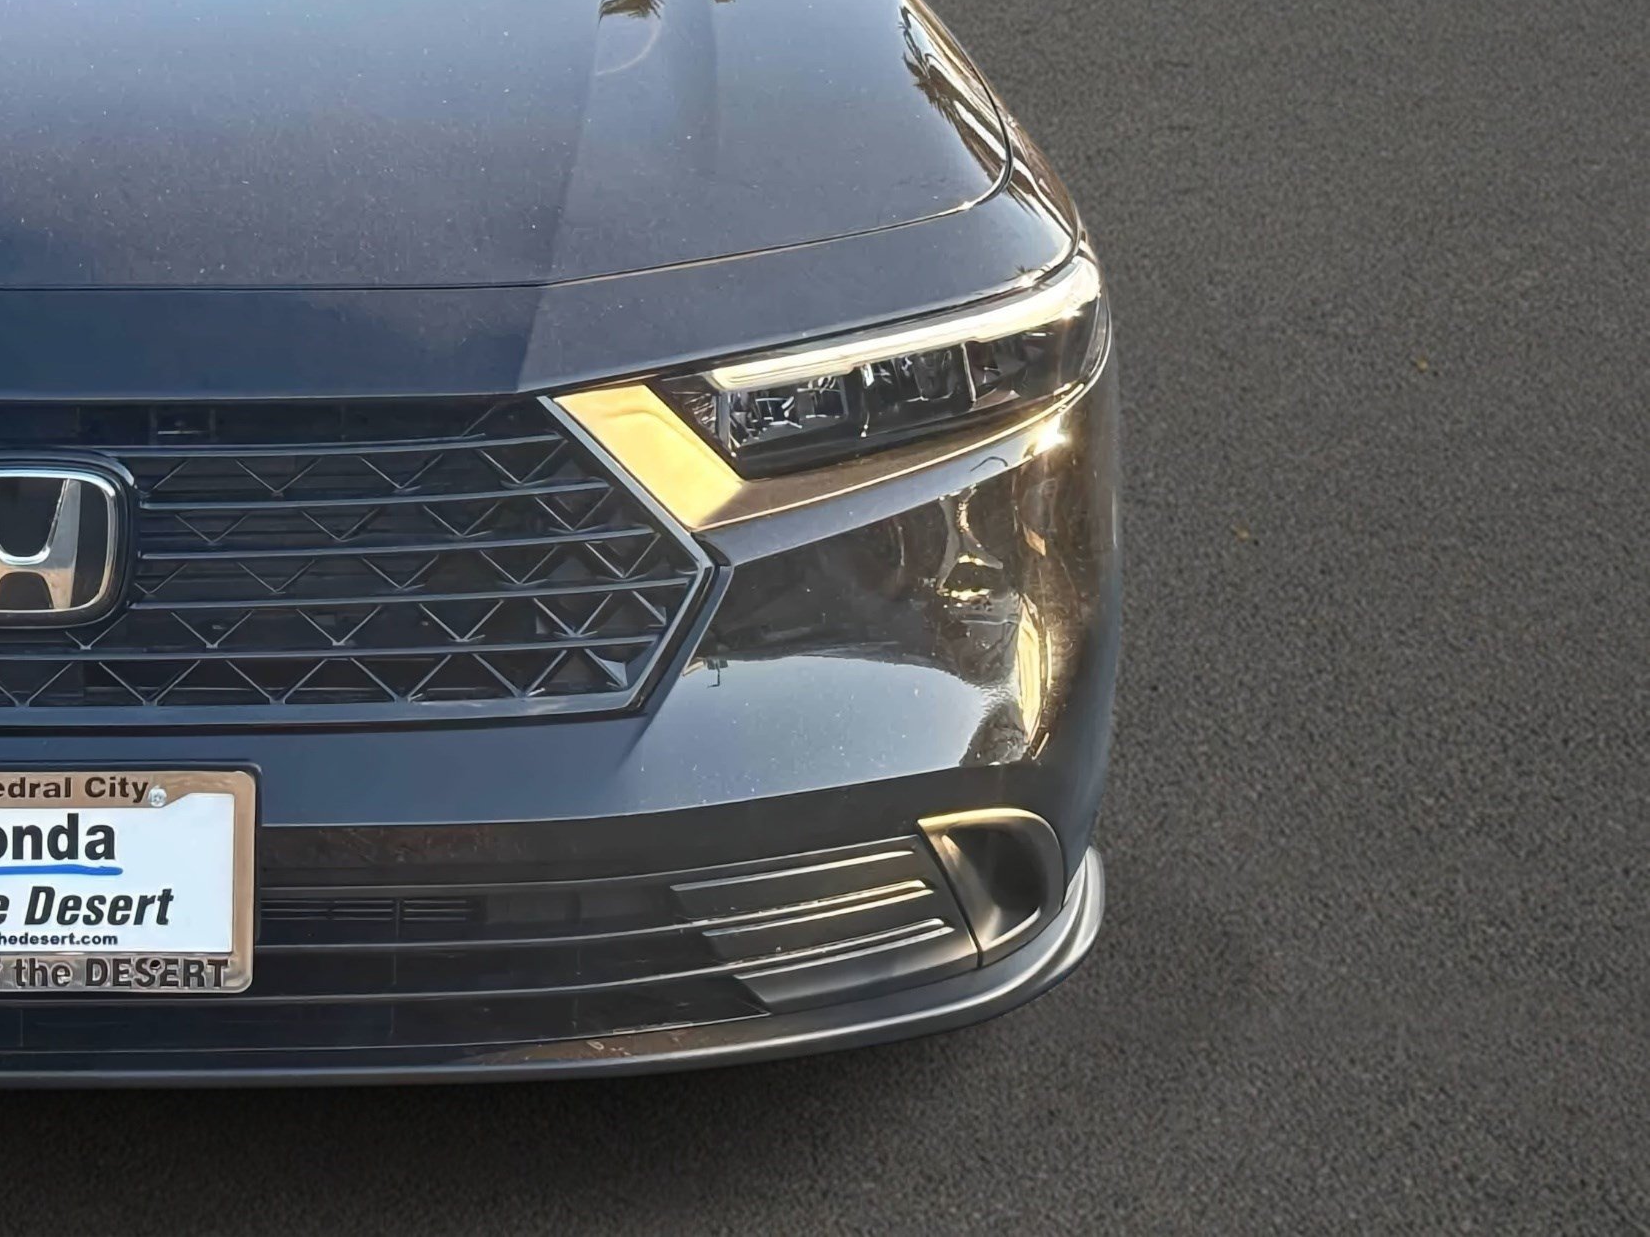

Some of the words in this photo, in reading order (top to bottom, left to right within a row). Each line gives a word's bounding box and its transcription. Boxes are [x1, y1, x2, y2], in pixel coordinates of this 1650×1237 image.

[84, 775, 149, 804] City
[24, 885, 175, 926] Desert
[13, 957, 72, 988] the
[85, 957, 229, 988] DESERT
